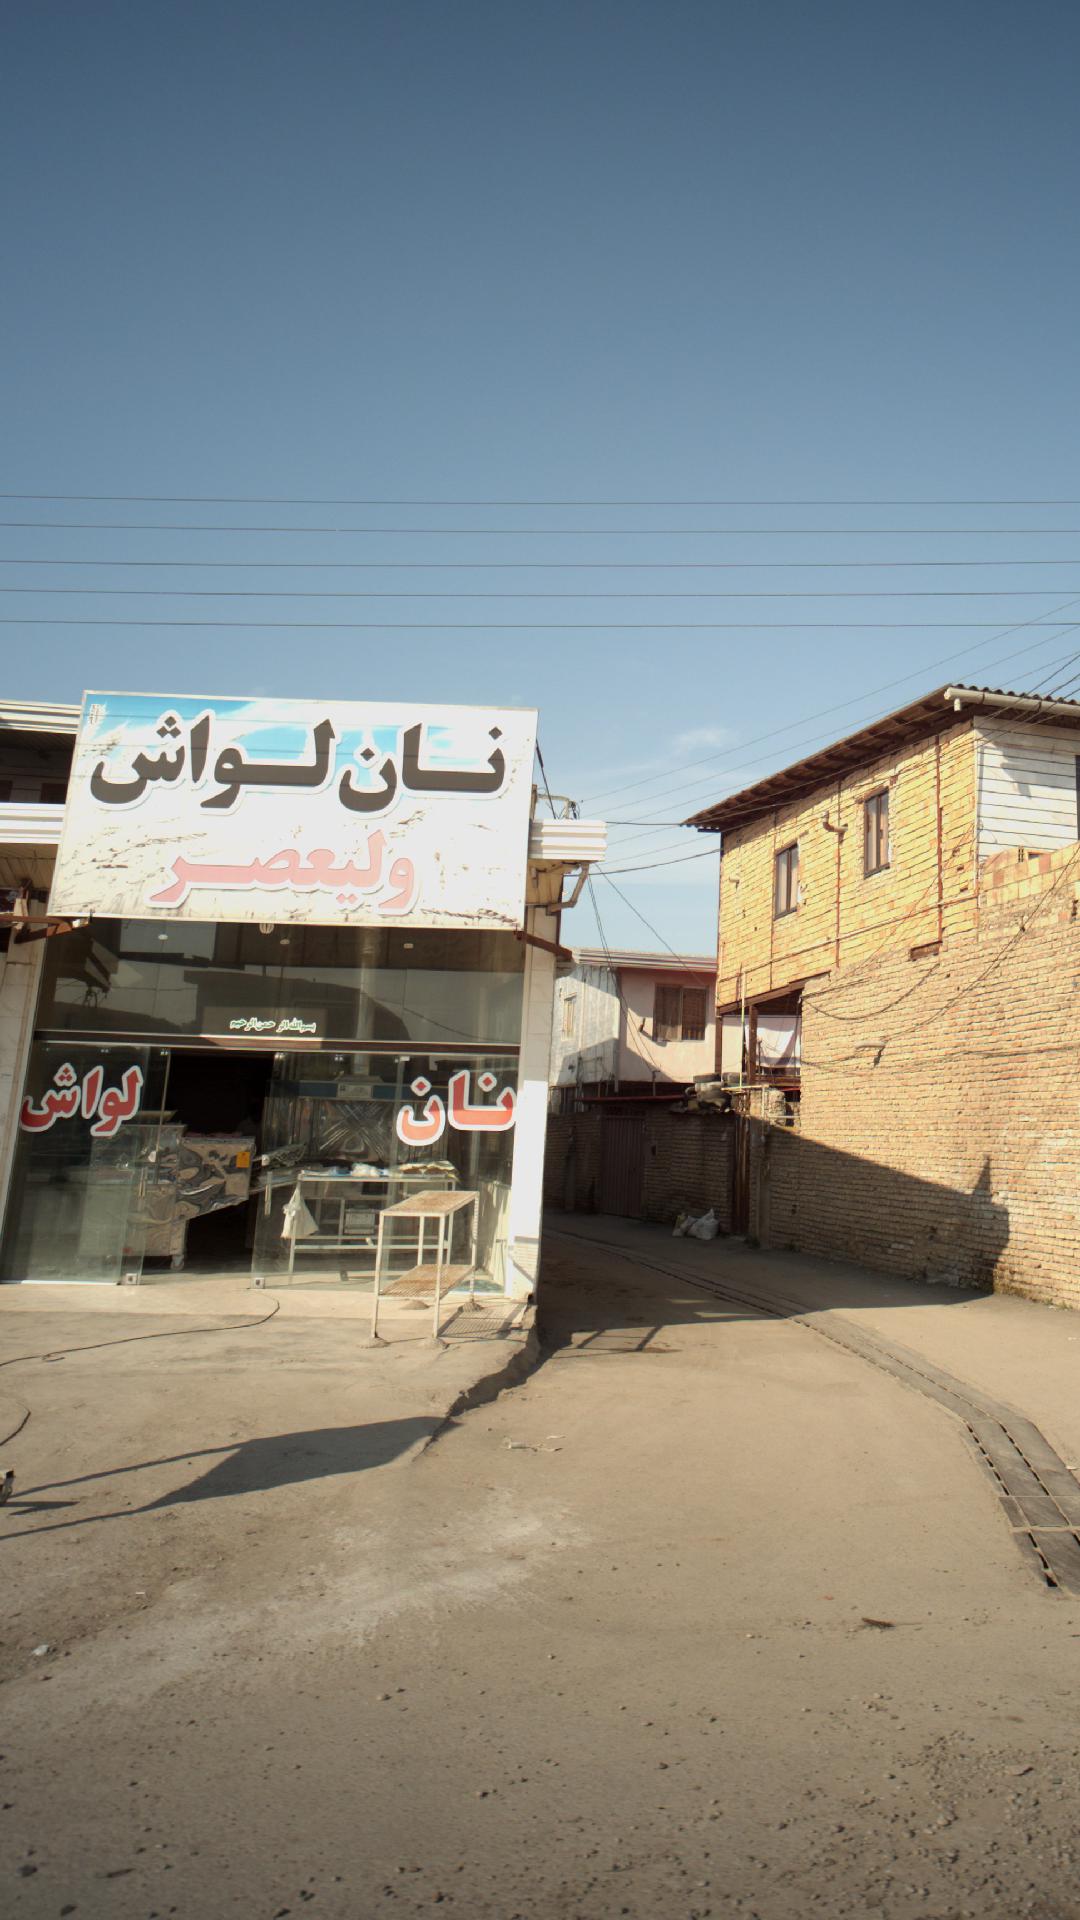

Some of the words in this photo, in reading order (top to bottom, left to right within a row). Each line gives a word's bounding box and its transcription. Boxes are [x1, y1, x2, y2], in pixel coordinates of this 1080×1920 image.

[89, 713, 336, 811] لواش
[338, 722, 507, 813] نان
[20, 1062, 144, 1137] لواش
[396, 1069, 517, 1146] نان
